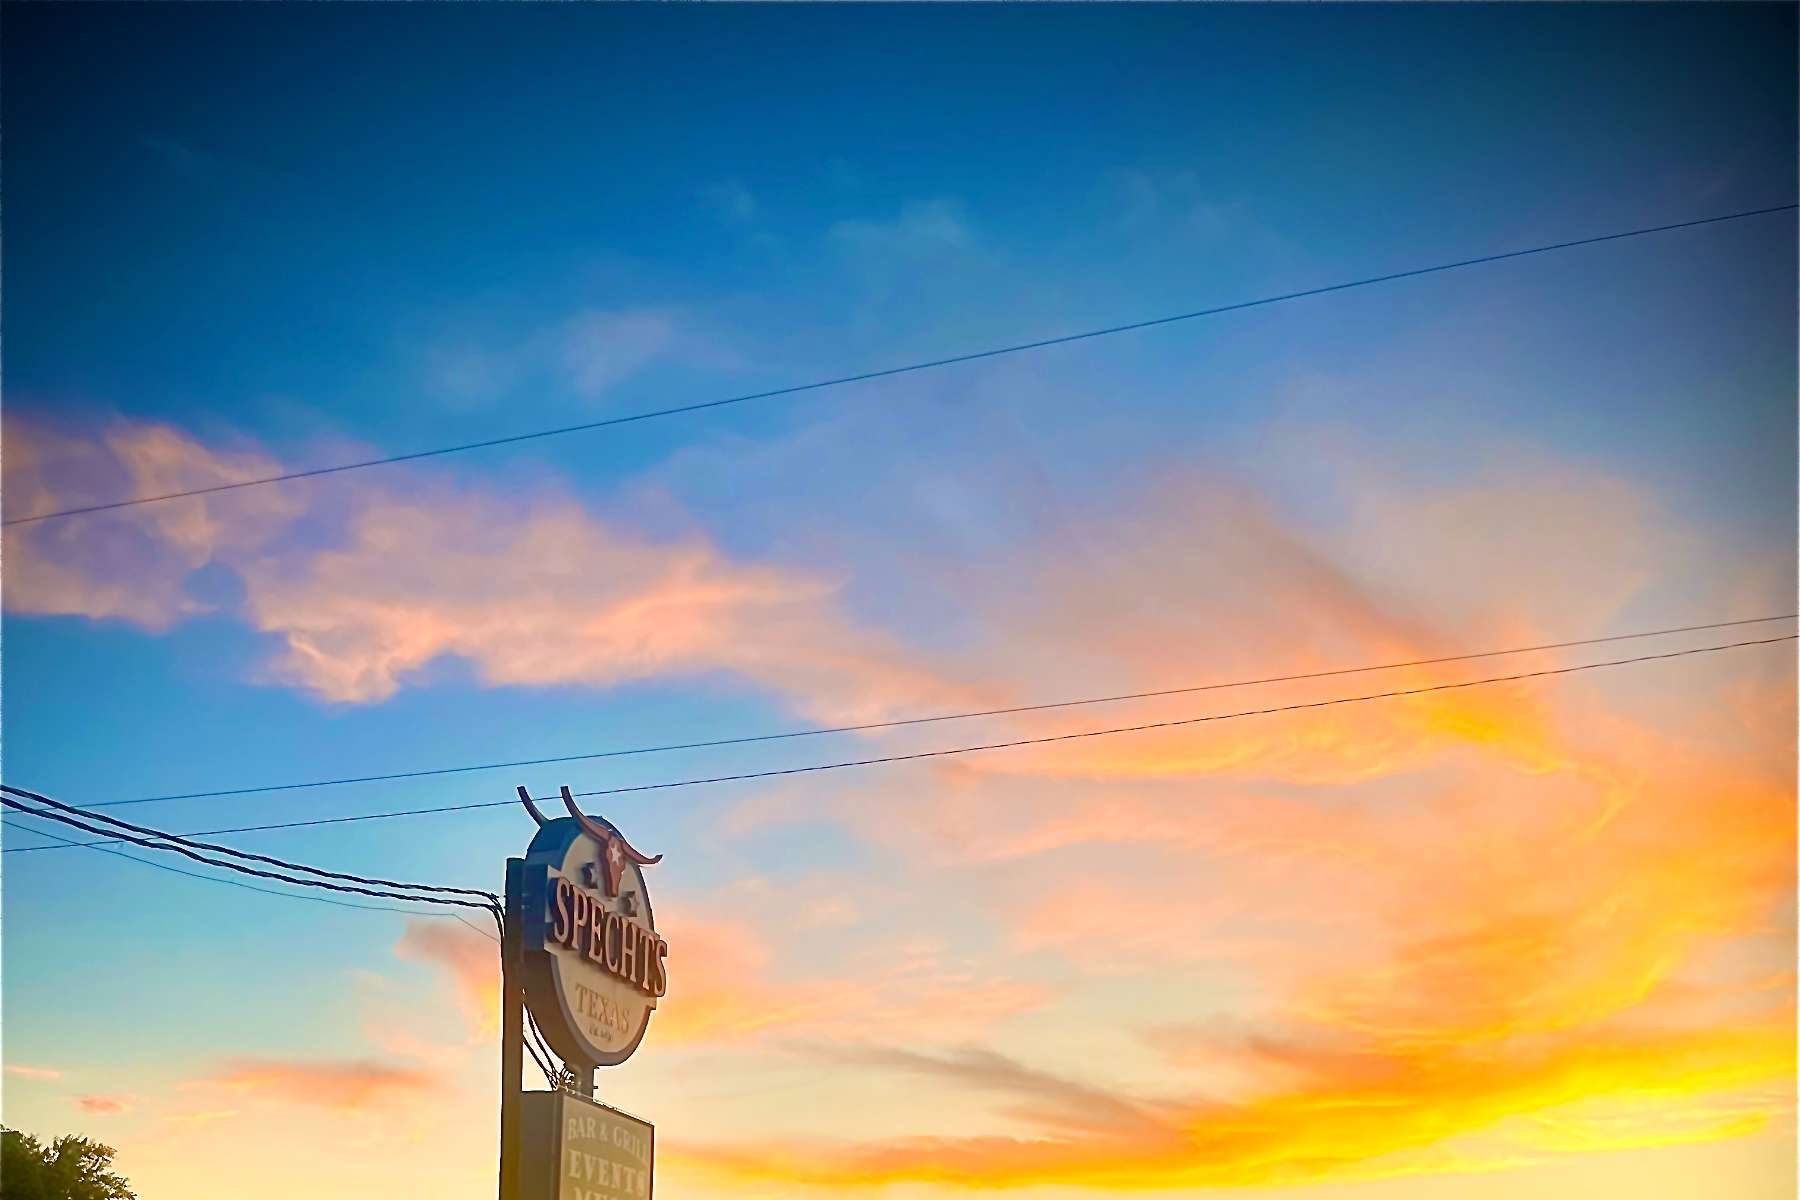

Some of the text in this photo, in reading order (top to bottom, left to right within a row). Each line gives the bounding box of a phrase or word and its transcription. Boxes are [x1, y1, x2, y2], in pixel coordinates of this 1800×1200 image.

[575, 982, 630, 1034] TEXAS
[567, 1117, 648, 1168] BAR & GRILL
[567, 1148, 646, 1197] EVENTS
